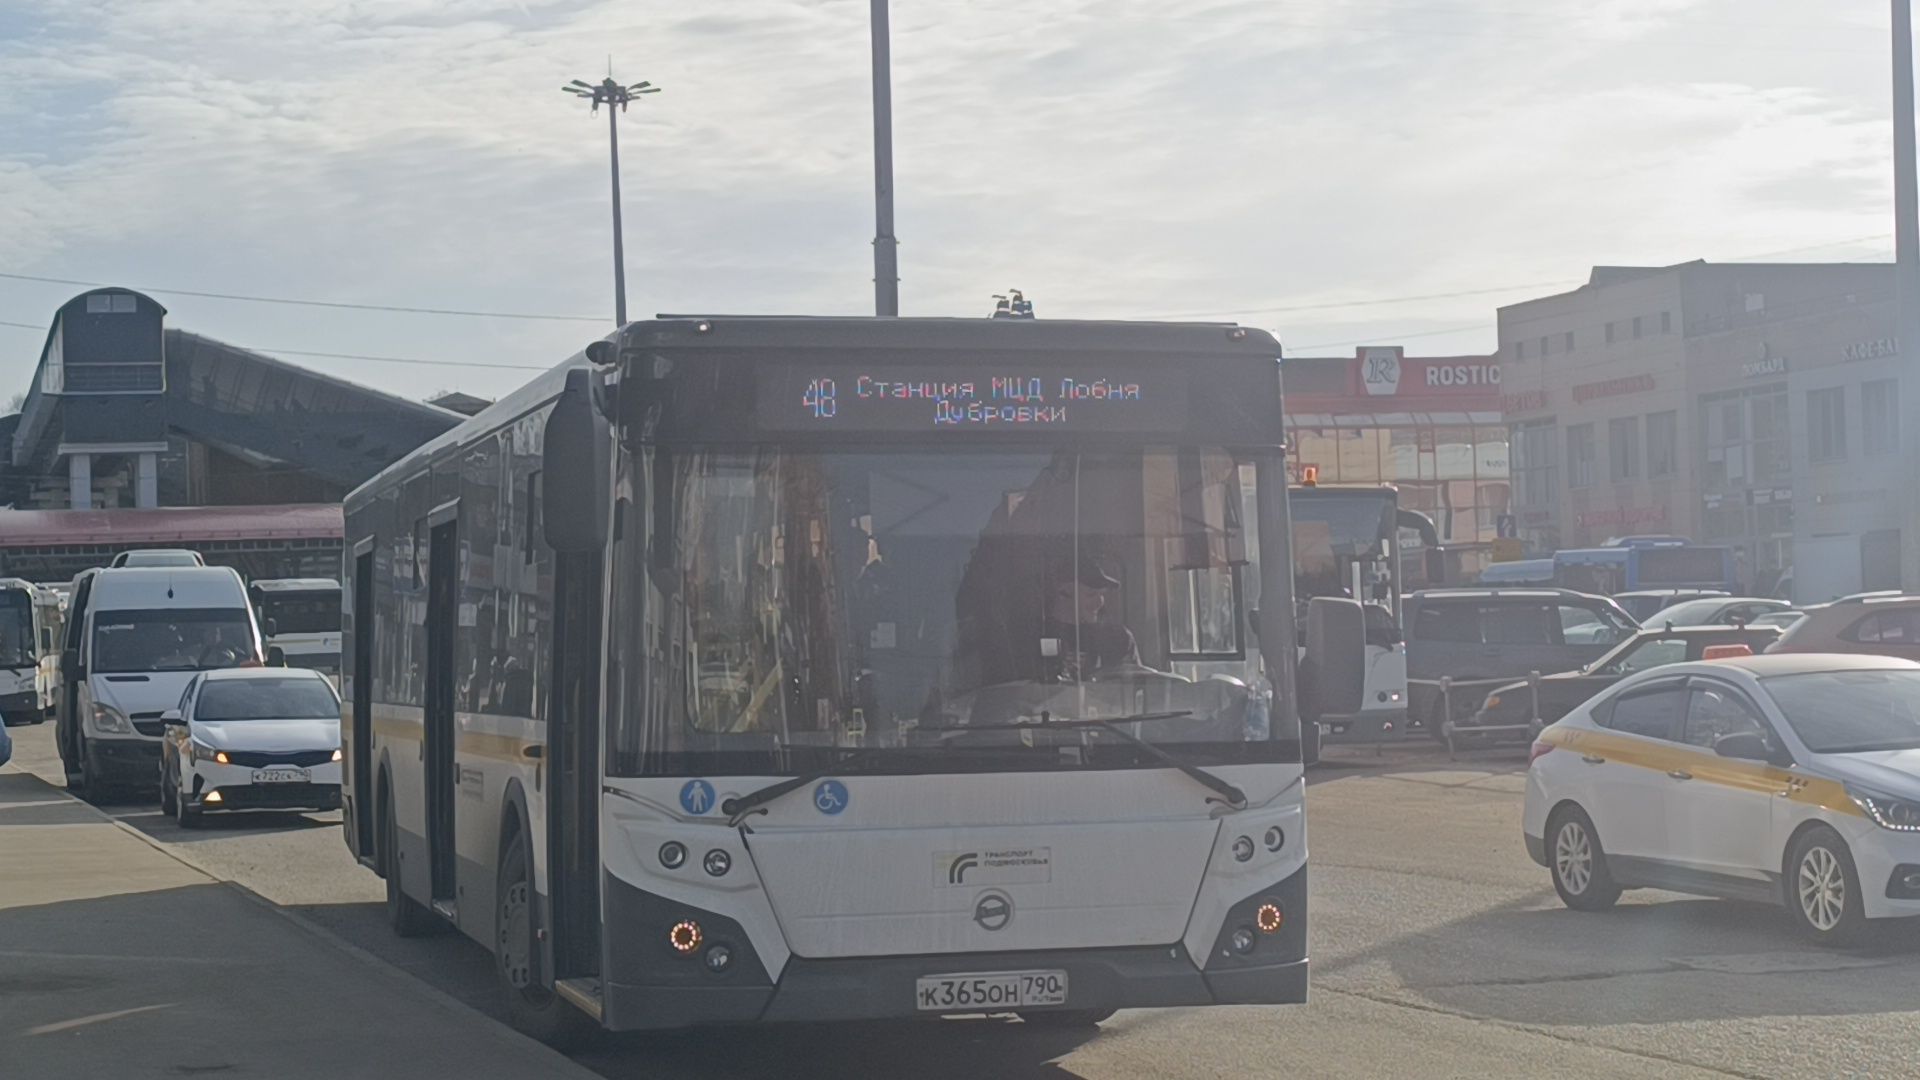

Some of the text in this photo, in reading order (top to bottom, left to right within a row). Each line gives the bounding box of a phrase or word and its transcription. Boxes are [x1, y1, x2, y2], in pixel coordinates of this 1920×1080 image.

[1426, 364, 1500, 386] ROSTIC
[857, 376, 1140, 403] Станция МЦД Лобня
[934, 400, 1066, 425] Дубровки
[984, 850, 1033, 859] ТРАНСПОРТ
